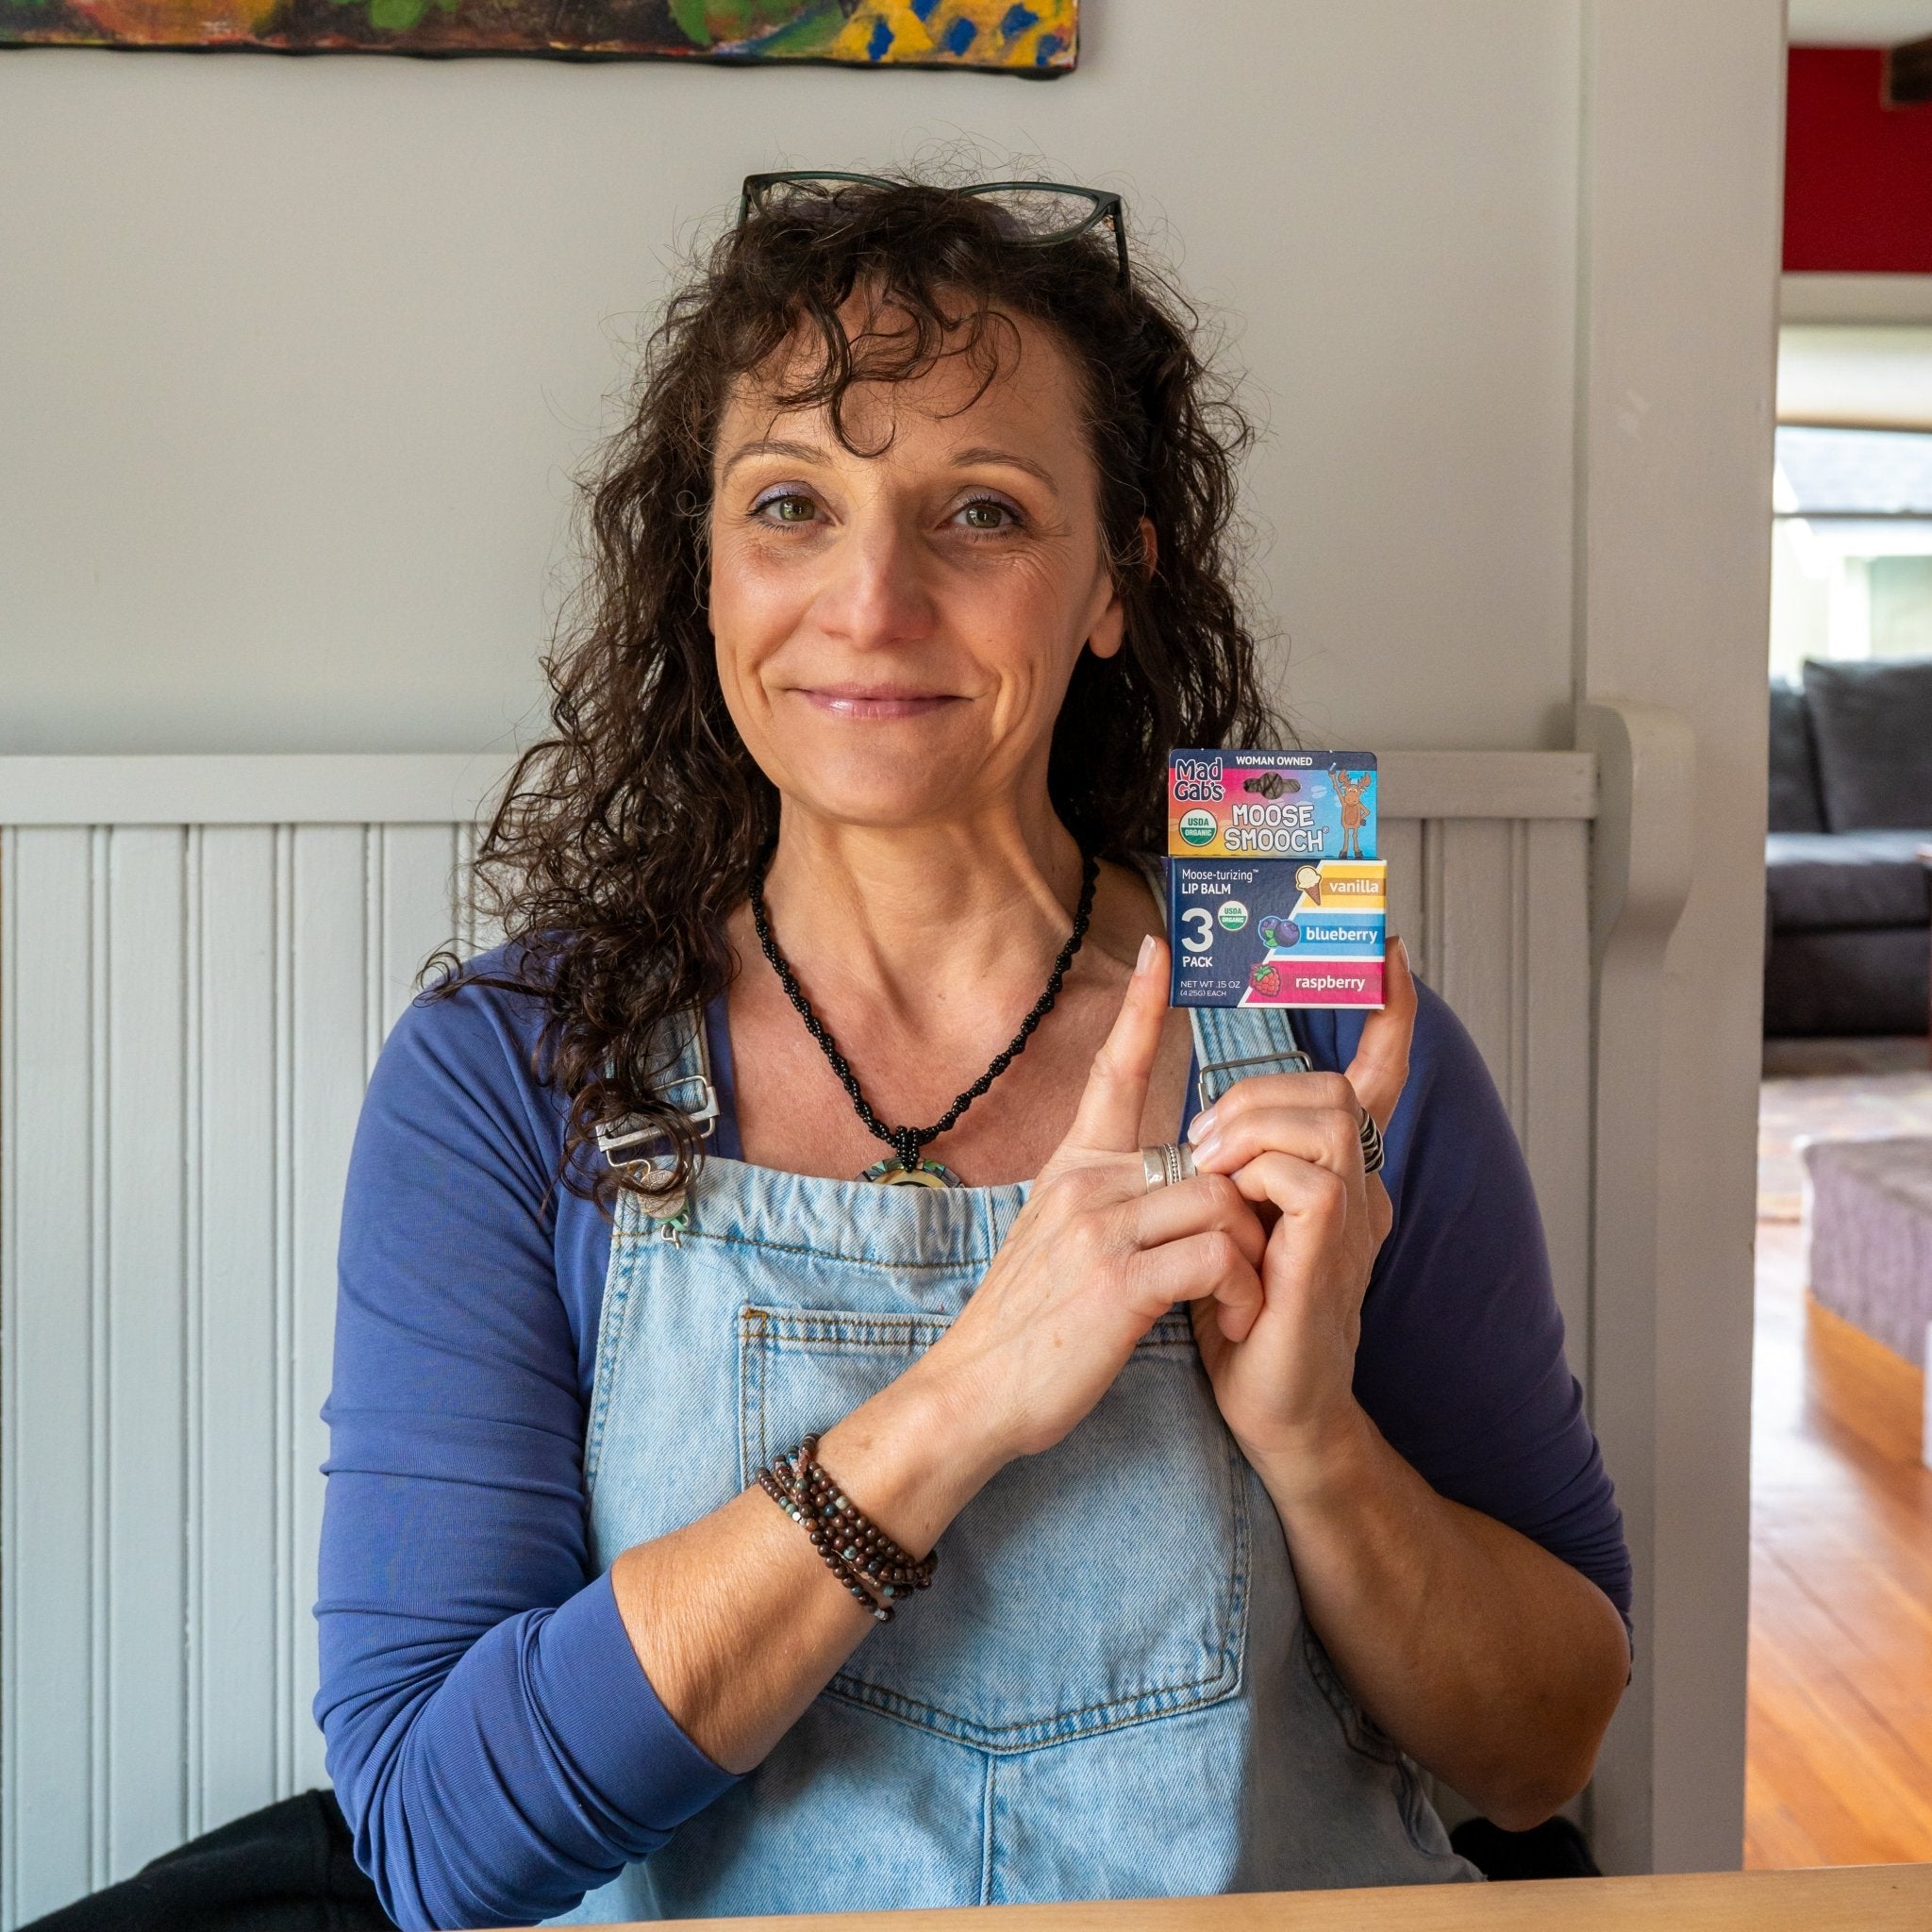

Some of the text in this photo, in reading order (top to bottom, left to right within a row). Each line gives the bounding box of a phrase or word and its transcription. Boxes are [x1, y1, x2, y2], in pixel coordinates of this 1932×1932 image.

[1236, 756, 1312, 766] WOMAN OWNED
[1175, 757, 1223, 782] Mad
[1174, 780, 1225, 802] Gab's
[1188, 818, 1209, 826] USDA
[1232, 804, 1315, 828] MOOSE
[1181, 883, 1231, 894] LIP BALM
[1329, 879, 1379, 892] vanilla
[1181, 908, 1214, 953] 3
[1306, 926, 1378, 944] blueberry
[1182, 956, 1213, 968] PACK
[1180, 980, 1198, 989] NET
[1199, 980, 1214, 989] WT
[1228, 980, 1241, 989] OZ
[1295, 975, 1366, 991] raspberry
